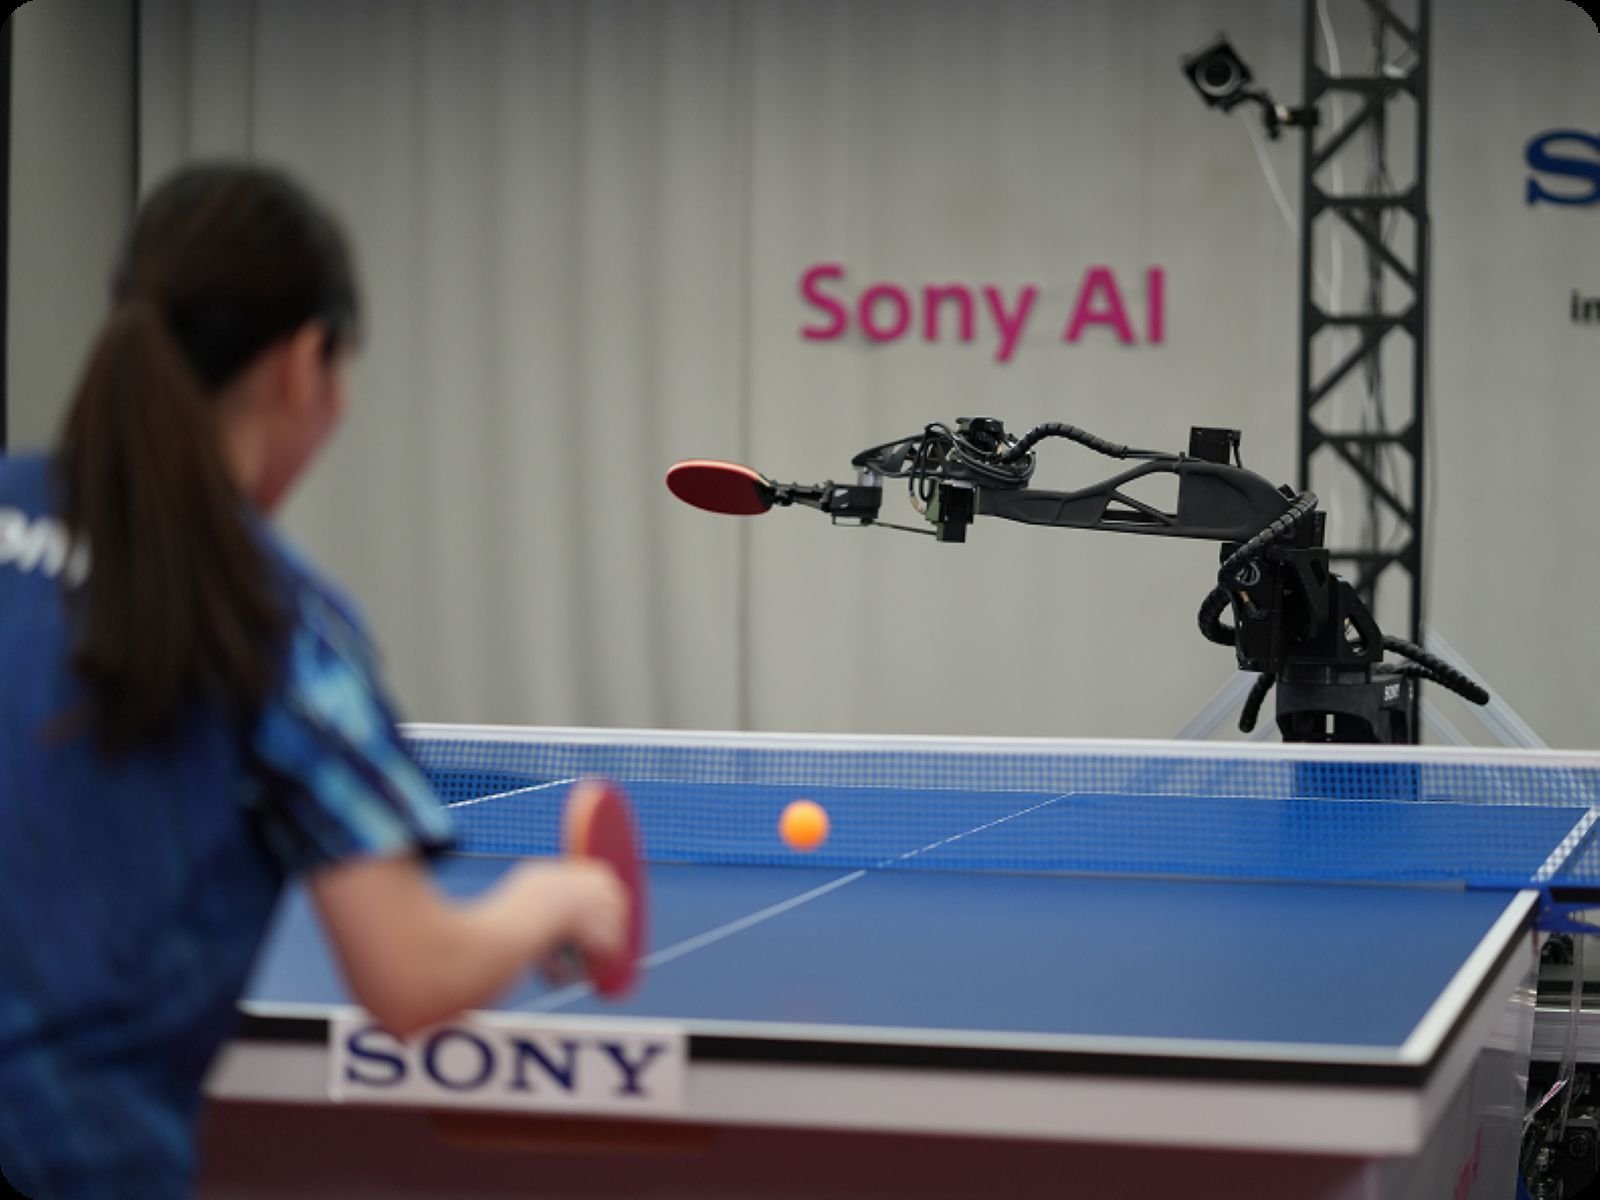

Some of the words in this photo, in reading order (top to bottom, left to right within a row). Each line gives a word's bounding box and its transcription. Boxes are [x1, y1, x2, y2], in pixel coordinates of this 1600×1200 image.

[797, 262, 1038, 363] Sony
[1062, 264, 1166, 345] AI
[344, 1026, 666, 1097] SONY
